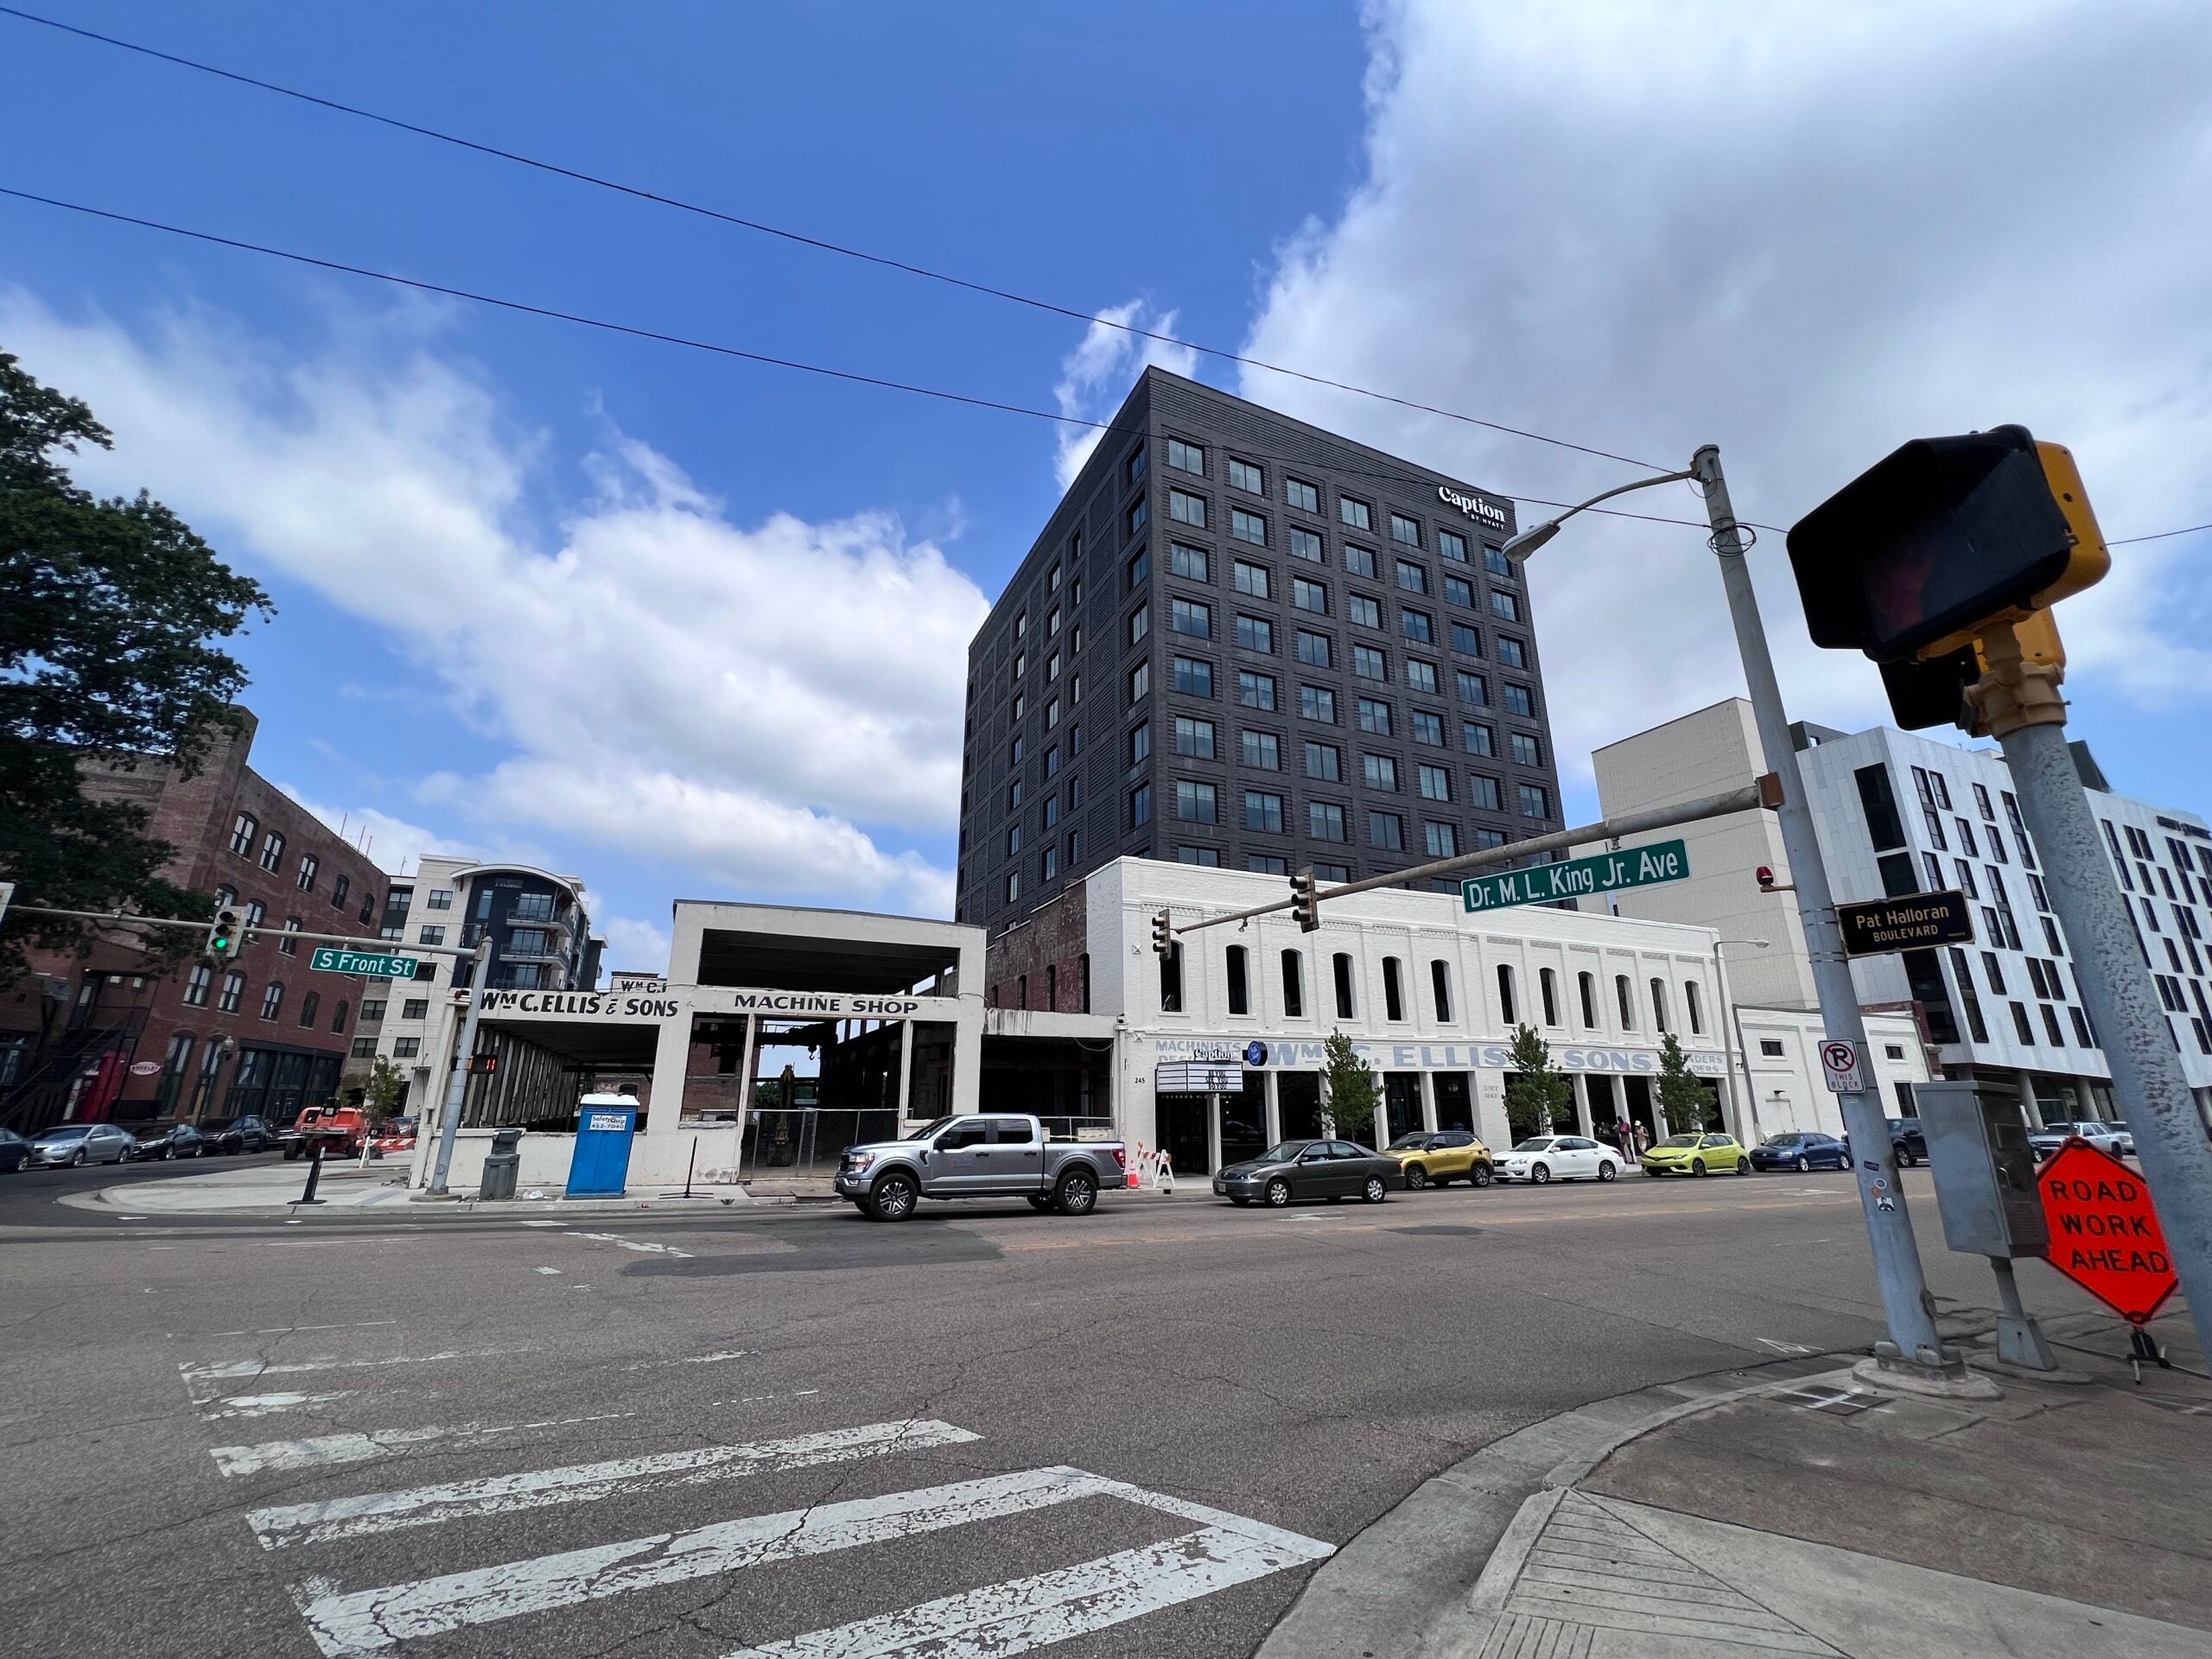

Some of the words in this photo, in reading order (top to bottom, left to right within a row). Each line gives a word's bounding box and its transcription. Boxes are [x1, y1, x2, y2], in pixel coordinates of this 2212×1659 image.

[1439, 486, 1505, 522] Caption
[1482, 518, 1504, 530] HYATT
[1468, 883, 1495, 907] Dr.
[1499, 876, 1521, 904] M.
[1524, 874, 1545, 899] L.
[1549, 865, 1594, 895] King
[1601, 857, 1631, 887] Jr.
[1638, 851, 1679, 880] Ave
[1856, 912, 1882, 930] Pat
[1885, 906, 1949, 925] Halloran
[1872, 925, 1938, 942] BOULEVARD
[320, 951, 334, 968] S
[338, 954, 385, 973] Front
[389, 958, 412, 976] St
[625, 998, 679, 1017] SONS
[734, 995, 841, 1012] MACHINE
[851, 1000, 918, 1014] SHOP
[1155, 1040, 1242, 1052] MACHINISTS
[486, 1059, 496, 1071] 11
[1393, 1046, 1508, 1068] ELLIS
[1563, 1049, 1652, 1071] SONS
[2049, 1179, 2138, 1202] ROAD
[2059, 1214, 2152, 1237] WORK
[2071, 1249, 2170, 1273] AHEAD
